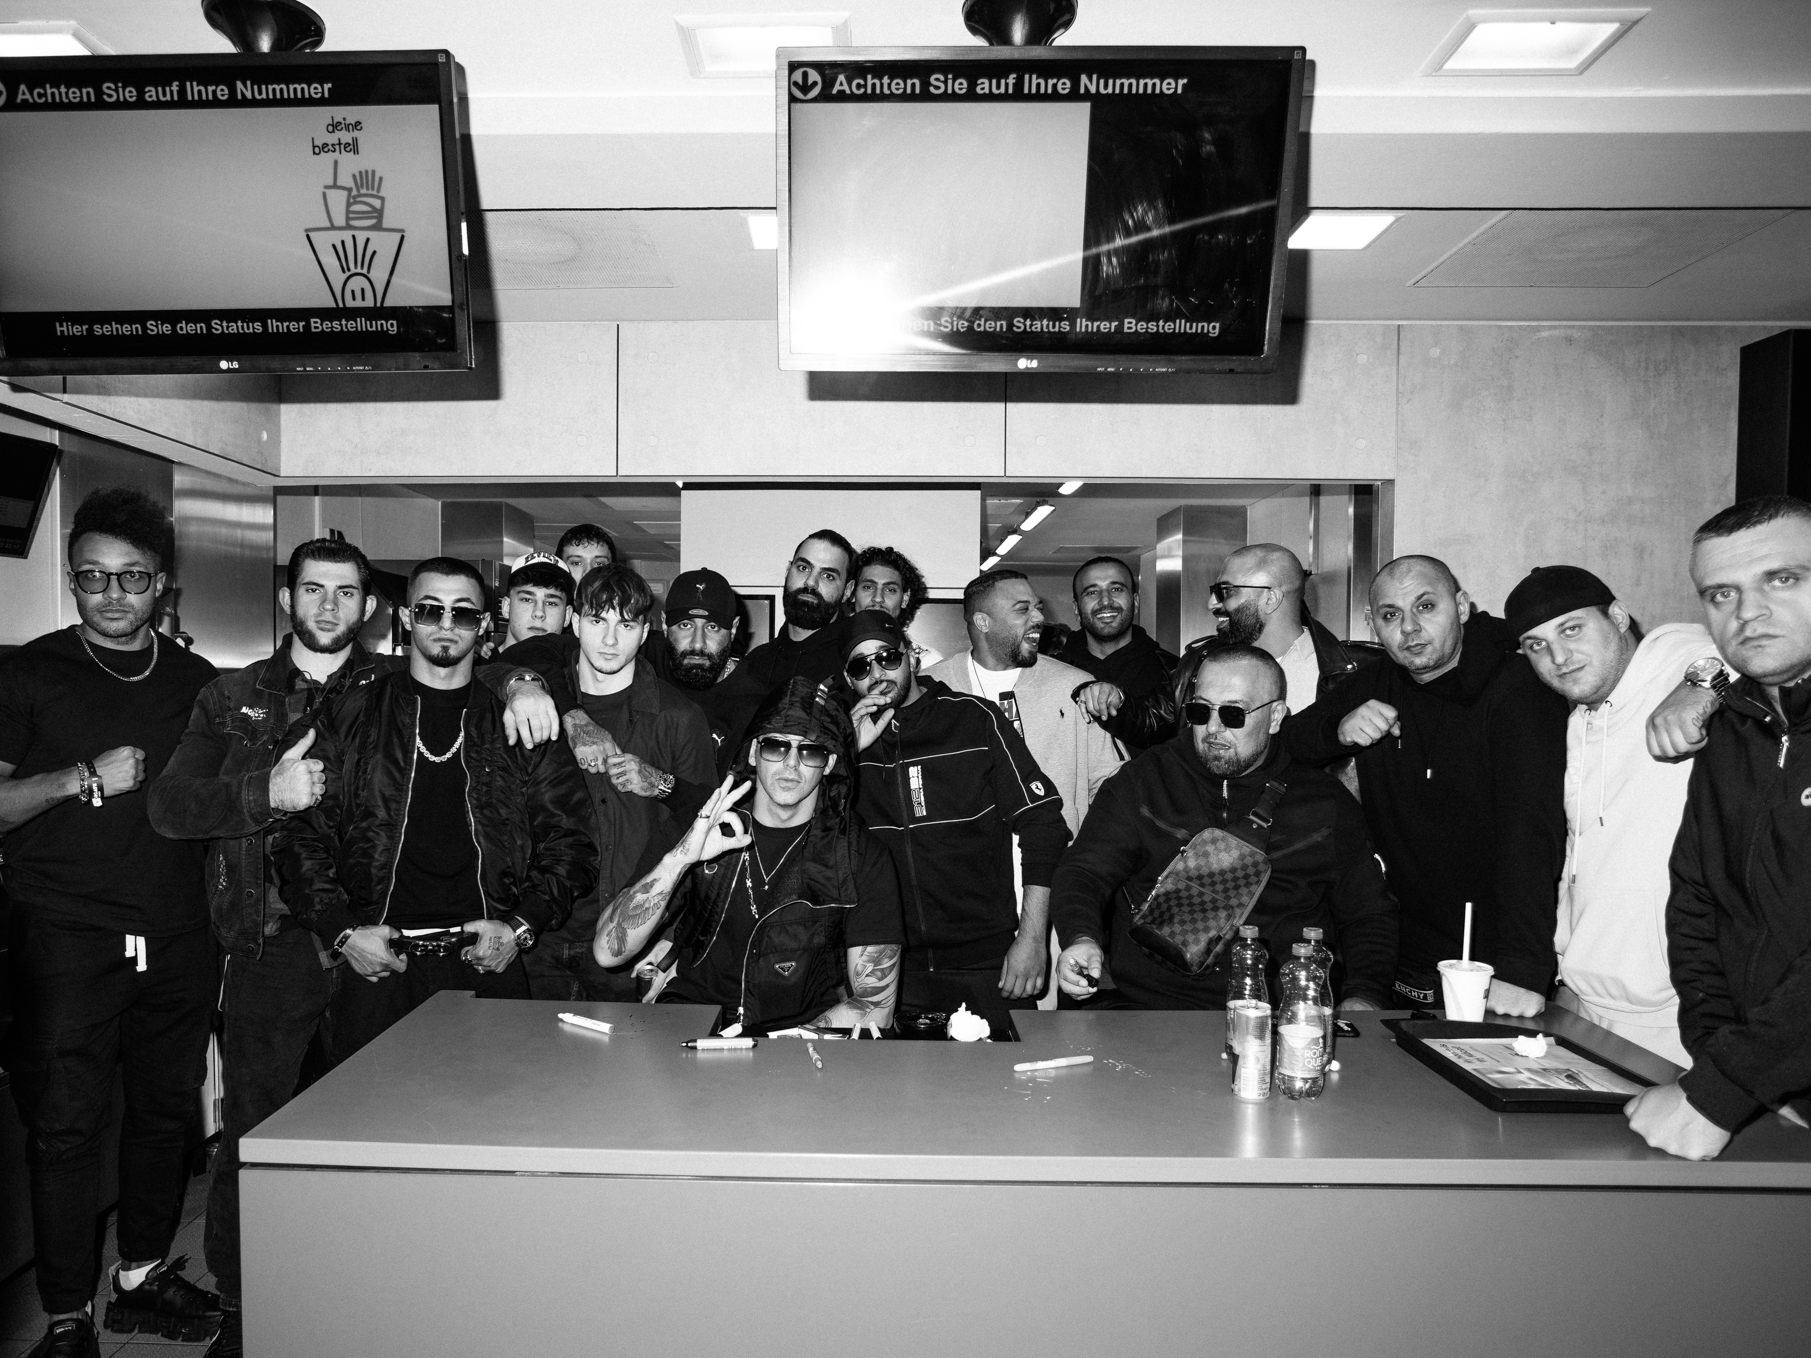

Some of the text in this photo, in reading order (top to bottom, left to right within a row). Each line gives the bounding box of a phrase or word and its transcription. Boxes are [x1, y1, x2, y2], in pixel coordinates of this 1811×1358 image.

[16, 81, 332, 103] Achten Sie auf Ihre Nummer
[832, 74, 1187, 94] Achten Sie auf Ihre Nummer
[327, 116, 362, 133] deine
[312, 137, 359, 155] bestell
[56, 318, 397, 335] Hier sehen Sie den Status Ihrer Bestellung
[940, 318, 967, 332] Sie
[974, 318, 1006, 331] den
[1012, 318, 1070, 332] Status
[1076, 318, 1118, 332] Ihrer
[1124, 319, 1219, 336] Bestellung
[1027, 359, 1038, 368] LG
